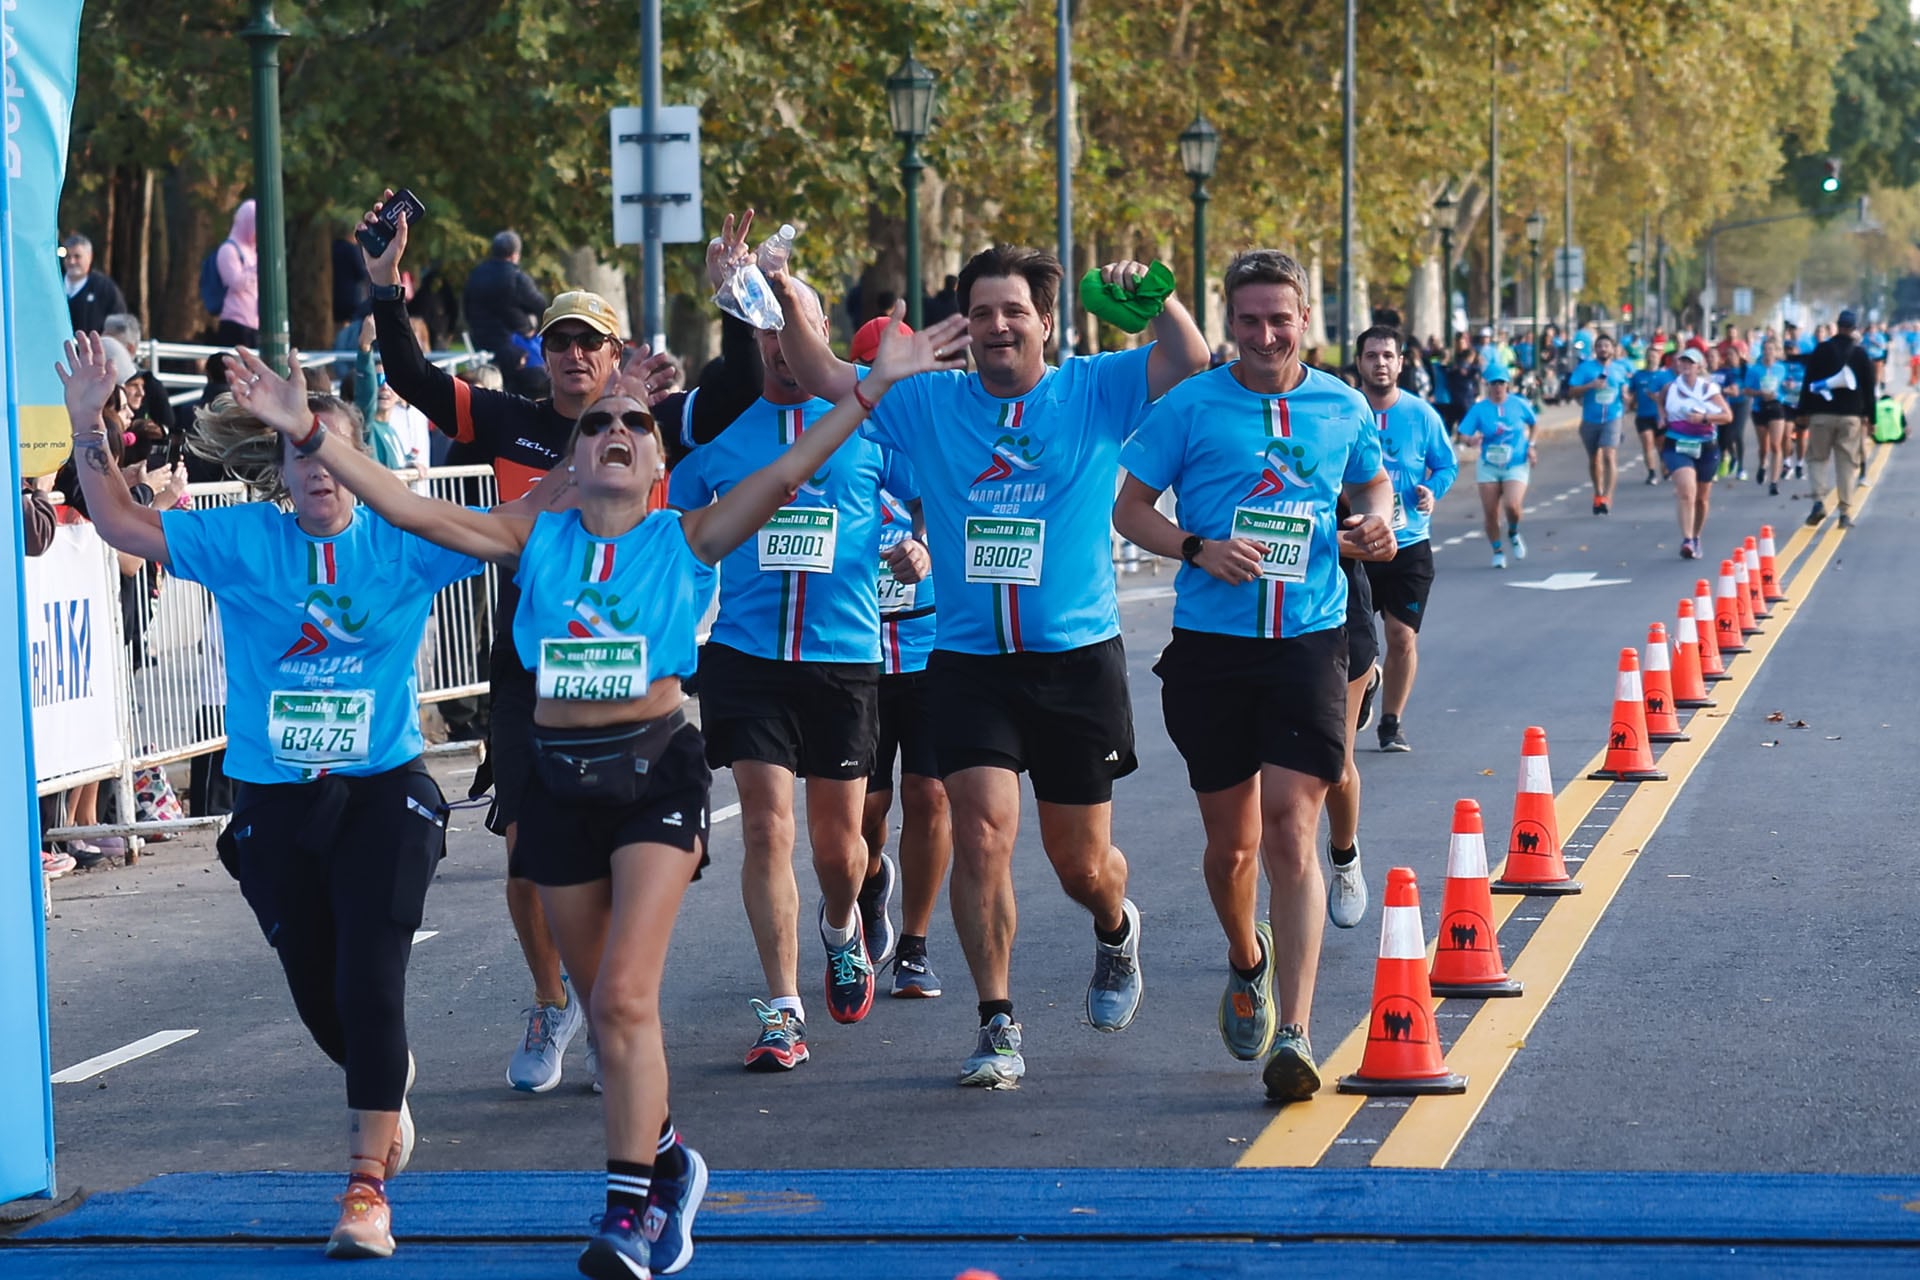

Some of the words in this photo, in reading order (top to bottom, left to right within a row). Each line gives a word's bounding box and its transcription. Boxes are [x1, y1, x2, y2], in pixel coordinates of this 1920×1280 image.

[33, 442, 48, 450] por
[992, 503, 1020, 514] 2026
[815, 515, 830, 526] 10K
[1020, 526, 1036, 537] 10K
[1291, 522, 1306, 533] 10K
[767, 535, 824, 557] B3001
[973, 545, 1033, 569] B3002
[1259, 541, 1301, 566] 003
[616, 648, 634, 660] 10K
[553, 675, 633, 699] B3499
[341, 703, 360, 714] 10K
[281, 726, 357, 752] B3475
